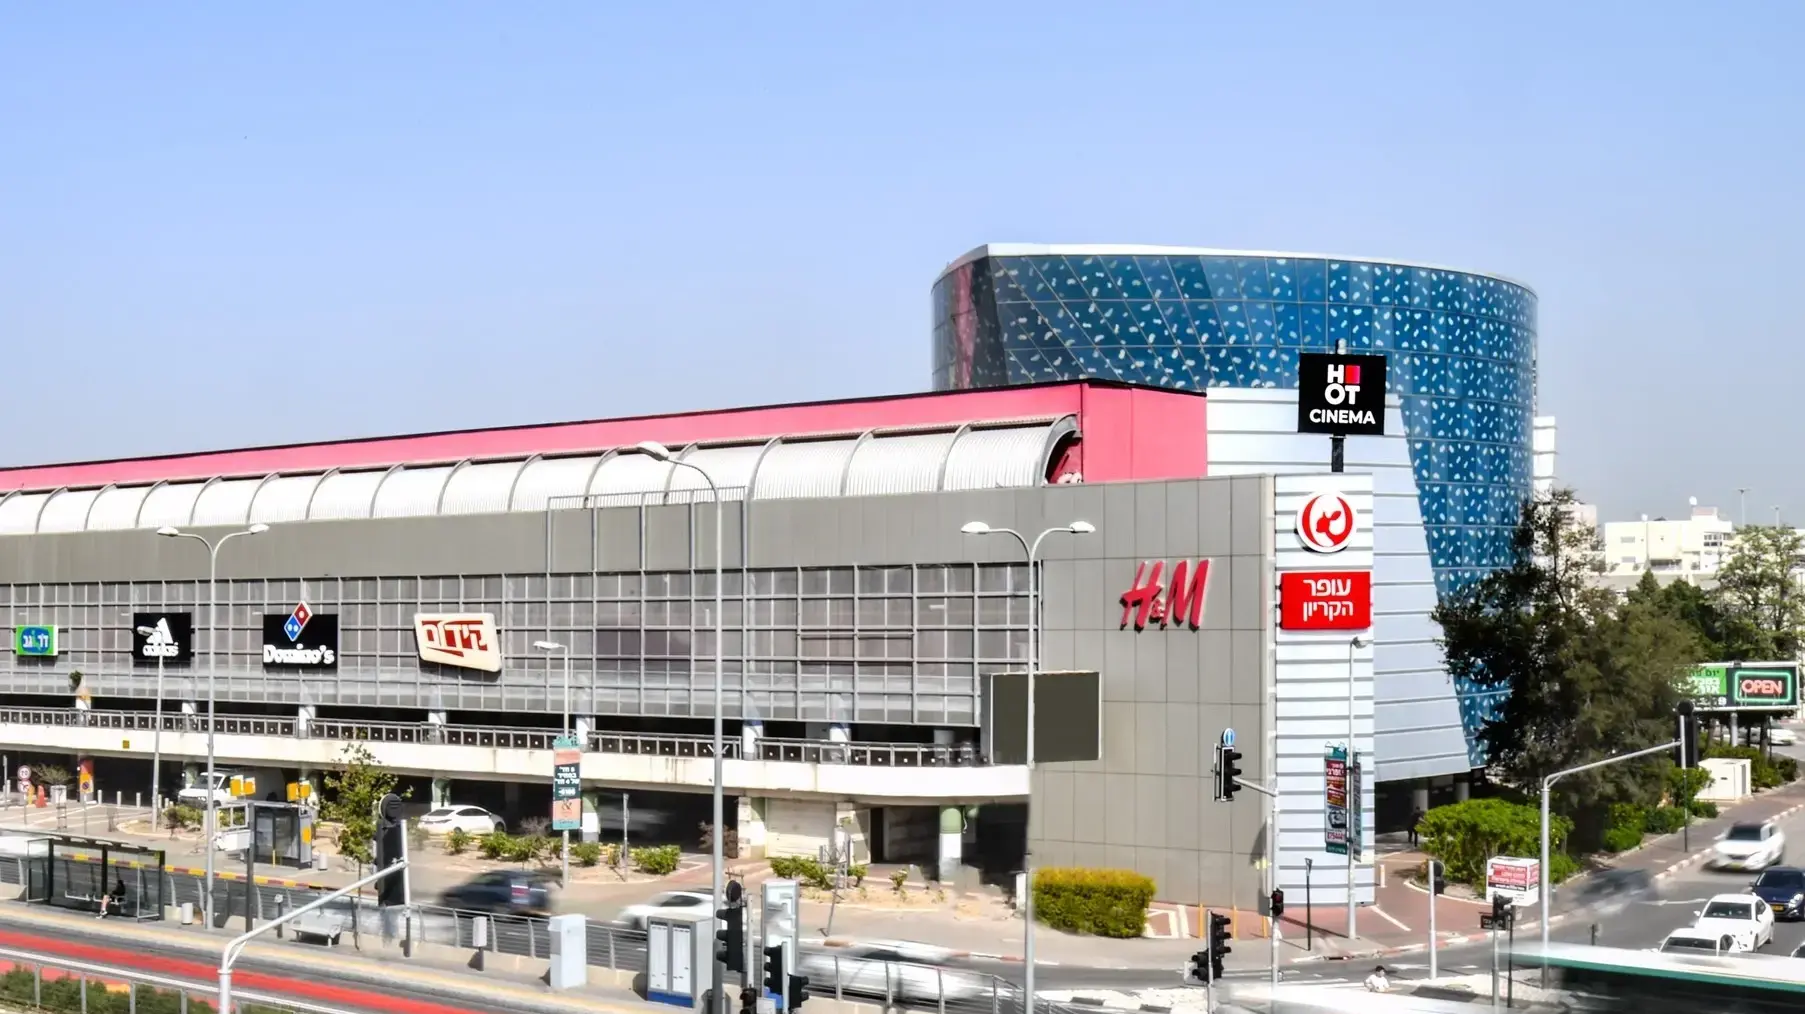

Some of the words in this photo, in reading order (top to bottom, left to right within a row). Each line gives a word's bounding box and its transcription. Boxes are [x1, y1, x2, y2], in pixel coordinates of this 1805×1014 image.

[1309, 408, 1376, 424] CINEMA
[1119, 559, 1211, 632] H&M
[1302, 578, 1351, 597] עופר
[1302, 600, 1354, 622] הקריון
[263, 643, 335, 665] Domino's
[1741, 679, 1783, 694] OPEN
